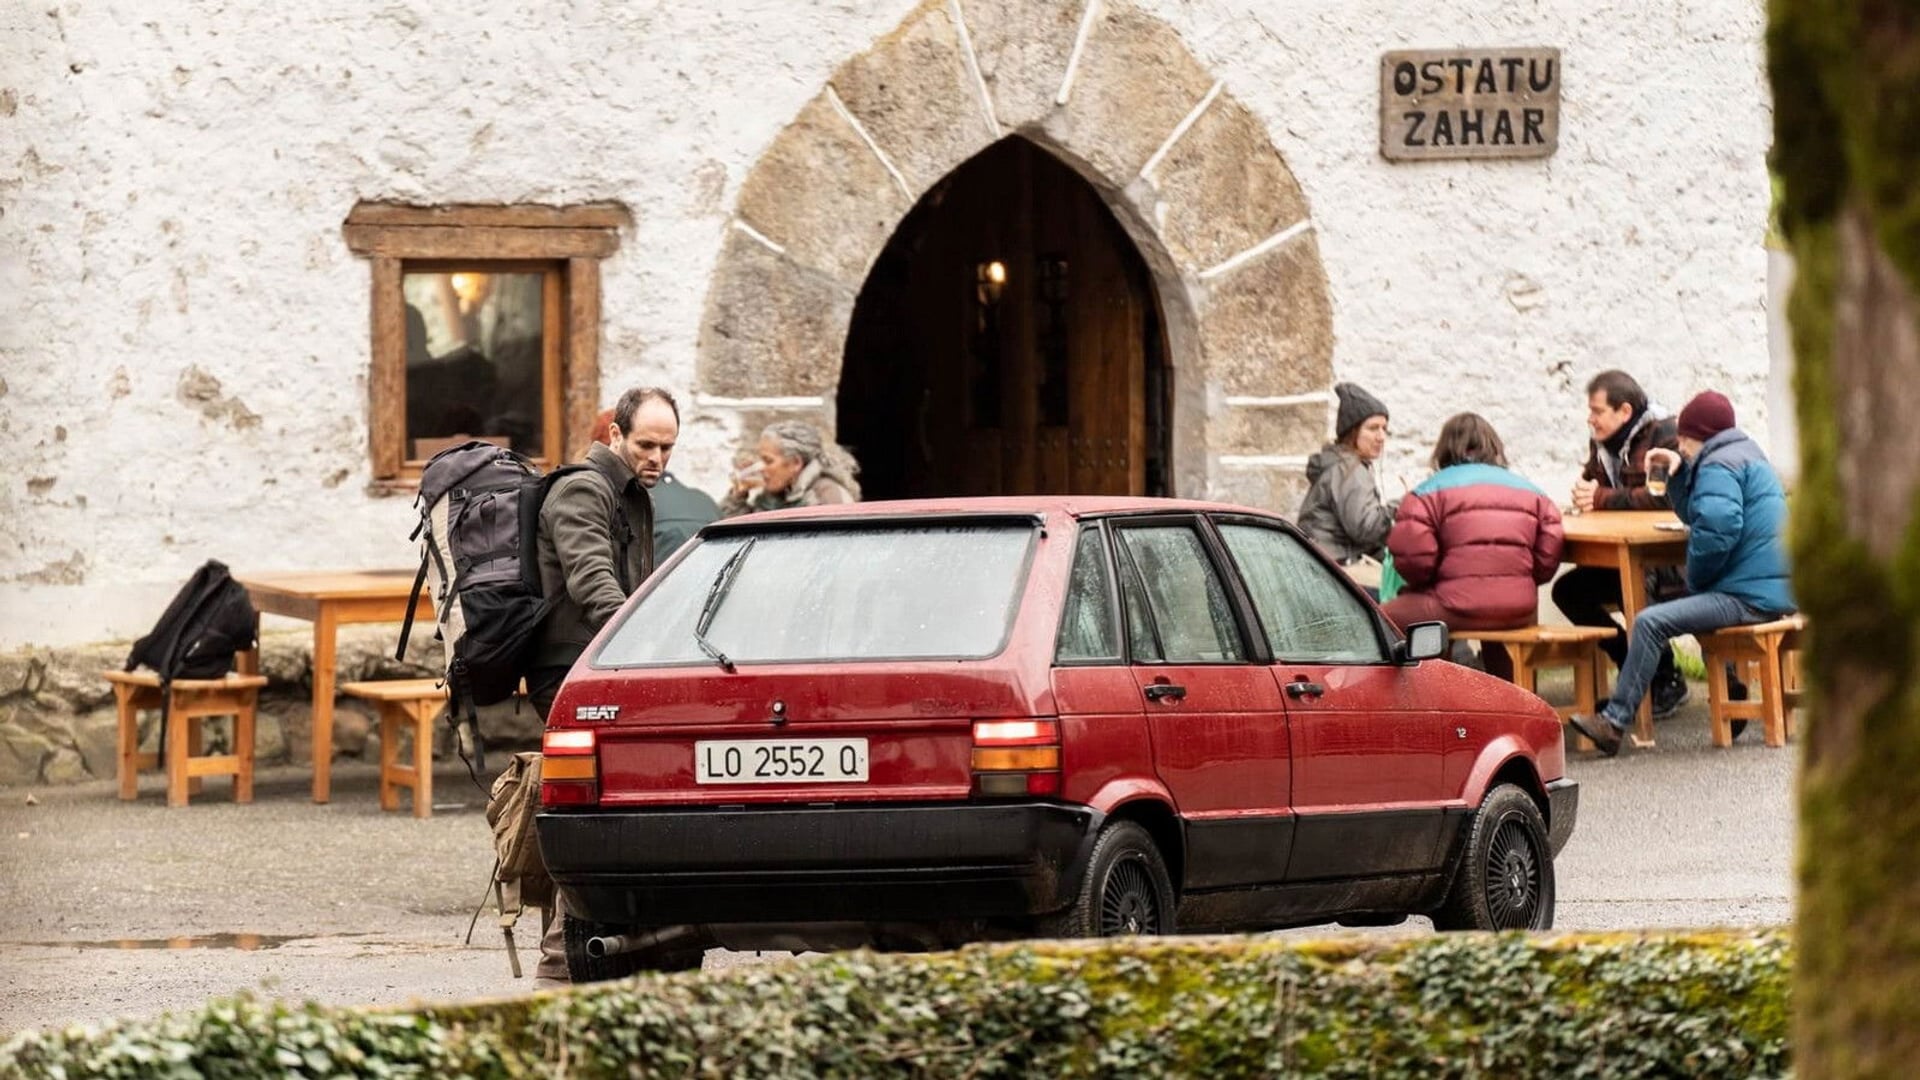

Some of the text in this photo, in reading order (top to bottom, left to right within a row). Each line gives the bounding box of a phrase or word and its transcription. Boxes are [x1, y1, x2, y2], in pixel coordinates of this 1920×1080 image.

[1394, 58, 1553, 96] OSTATU
[1403, 108, 1545, 146] ZAHAR
[576, 705, 620, 720] SEAT
[707, 745, 859, 778] LO 2552 Q
